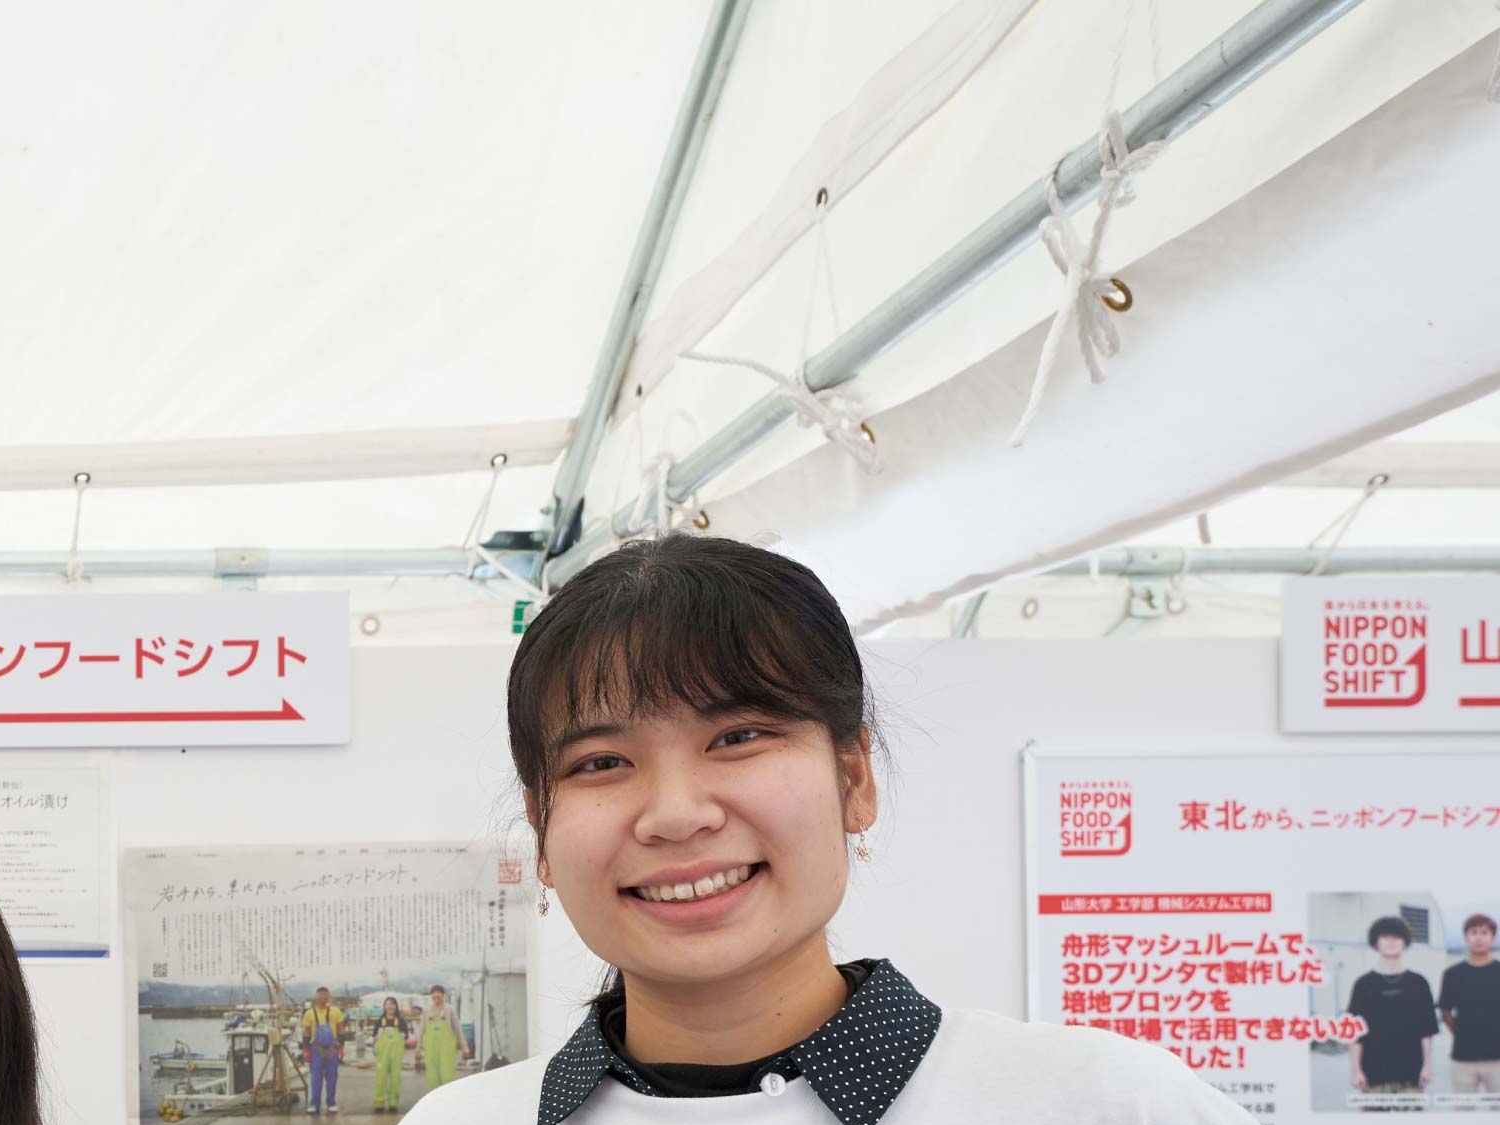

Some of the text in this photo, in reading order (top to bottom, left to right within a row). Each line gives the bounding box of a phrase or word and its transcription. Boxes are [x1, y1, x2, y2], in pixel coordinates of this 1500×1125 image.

[1325, 616, 1427, 640] NIPPON
[1325, 643, 1398, 667] FOOD
[1325, 670, 1407, 694] SHIFT
[1060, 793, 1132, 809] NIPPON
[1060, 812, 1112, 828] FOOD
[1060, 831, 1118, 848] SHIFT
[1061, 933, 1317, 958] 舟形マッシュルームで、
[1061, 960, 1323, 985] 3Dプリンタで製作した
[1061, 990, 1232, 1014] 培地ブロックを
